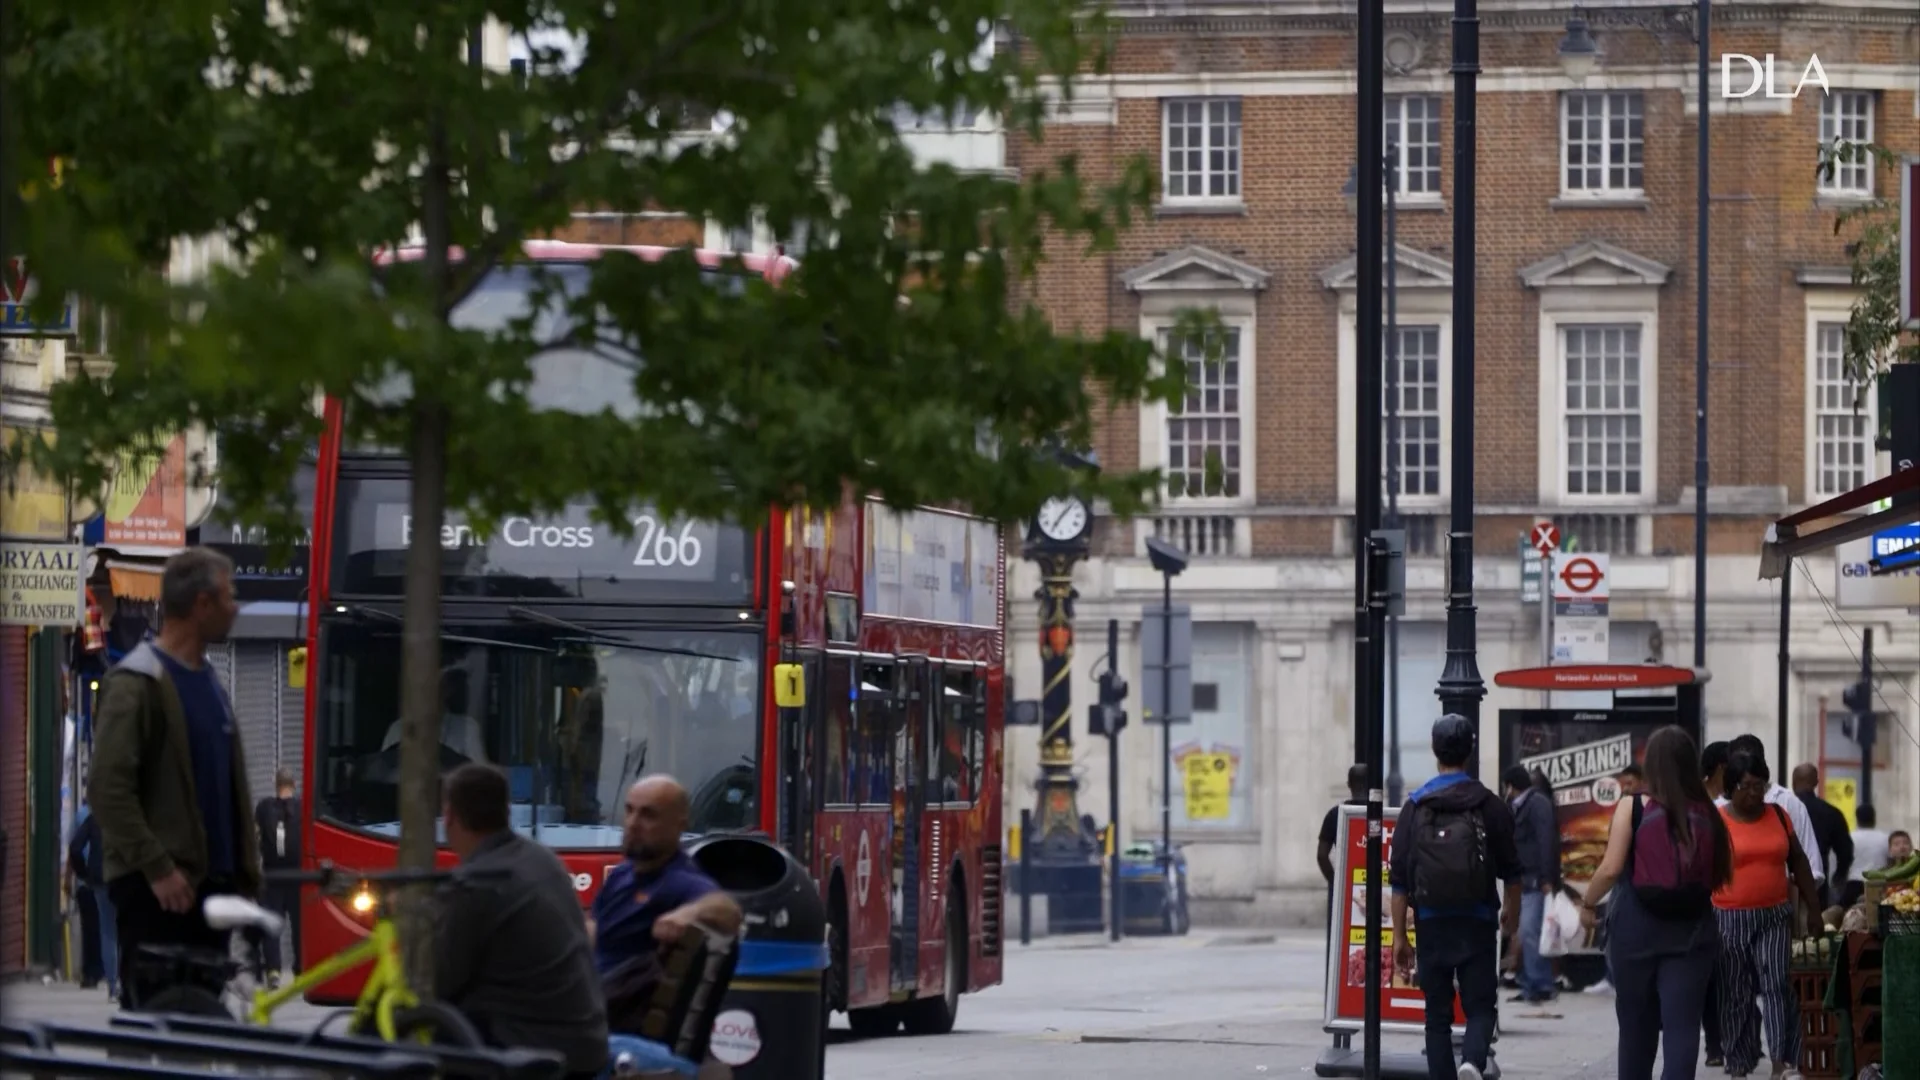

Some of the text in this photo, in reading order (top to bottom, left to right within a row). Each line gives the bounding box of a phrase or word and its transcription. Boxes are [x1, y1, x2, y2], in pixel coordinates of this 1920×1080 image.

[503, 516, 594, 548] Cross
[633, 515, 701, 566] 266
[0, 550, 79, 570] RYAAL
[12, 574, 78, 591] EXCHANGE
[12, 604, 76, 619] TRANSFER
[1574, 738, 1632, 776] RANCH
